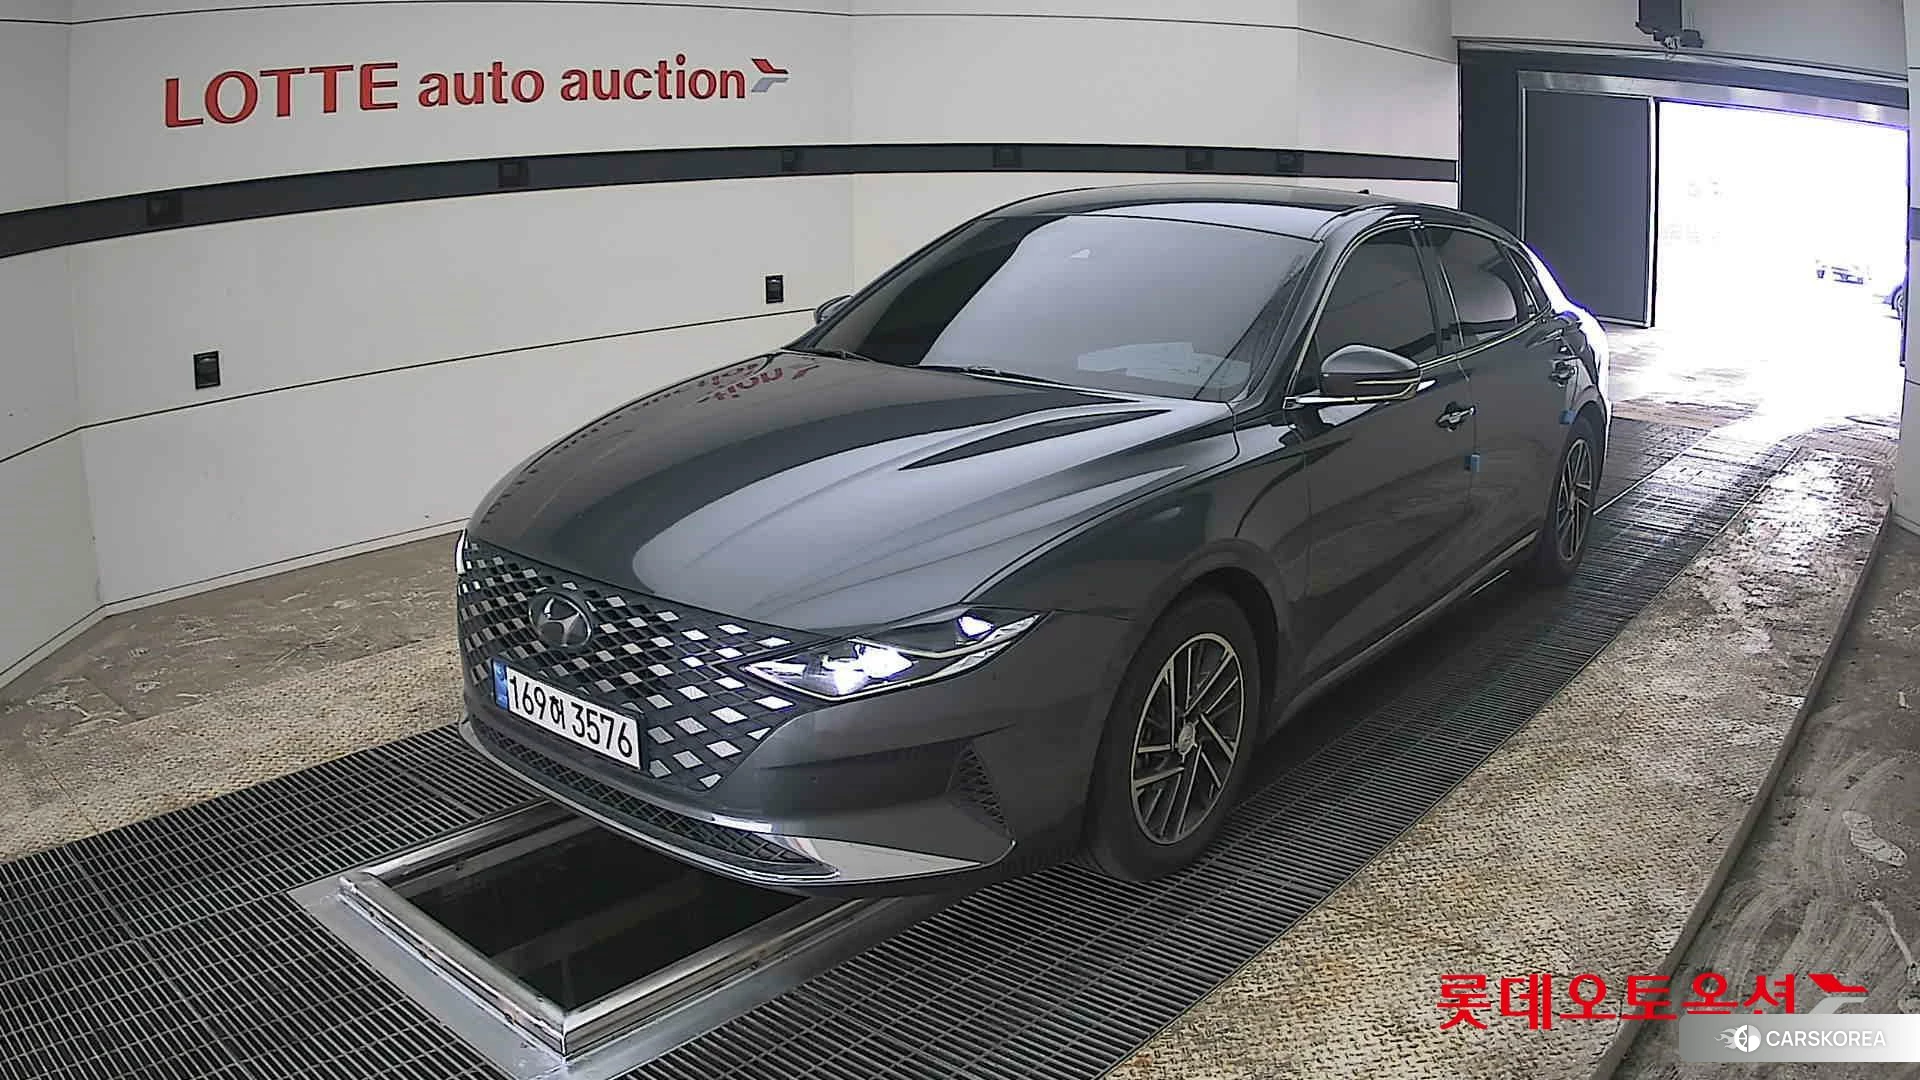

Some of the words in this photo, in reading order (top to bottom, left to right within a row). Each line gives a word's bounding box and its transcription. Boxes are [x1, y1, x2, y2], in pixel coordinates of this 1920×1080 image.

[165, 61, 399, 128] LOTTE
[418, 61, 545, 107] auto
[560, 54, 747, 101] auction
[509, 675, 566, 730] 169허
[570, 702, 633, 758] 3576
